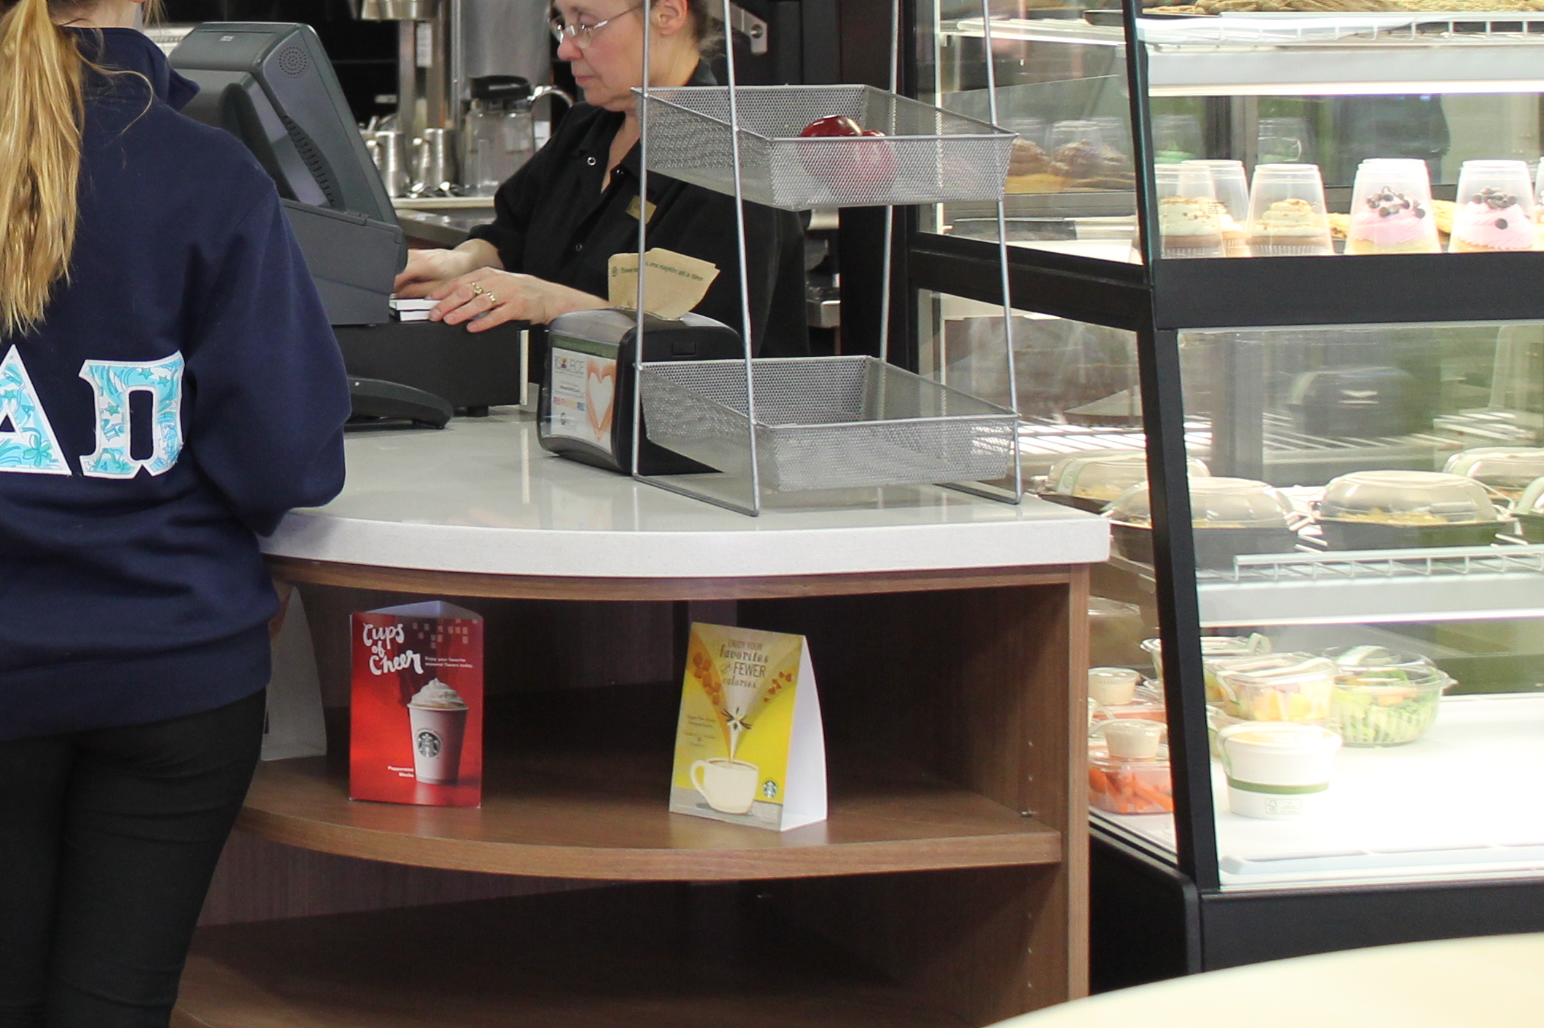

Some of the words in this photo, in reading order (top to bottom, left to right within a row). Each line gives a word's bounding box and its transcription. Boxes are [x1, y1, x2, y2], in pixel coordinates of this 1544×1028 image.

[363, 623, 405, 649] Cups
[371, 641, 386, 658] of
[719, 643, 769, 664] favorites
[369, 649, 424, 676] Cheer
[733, 662, 766, 678] FEWER
[722, 675, 757, 688] calories
